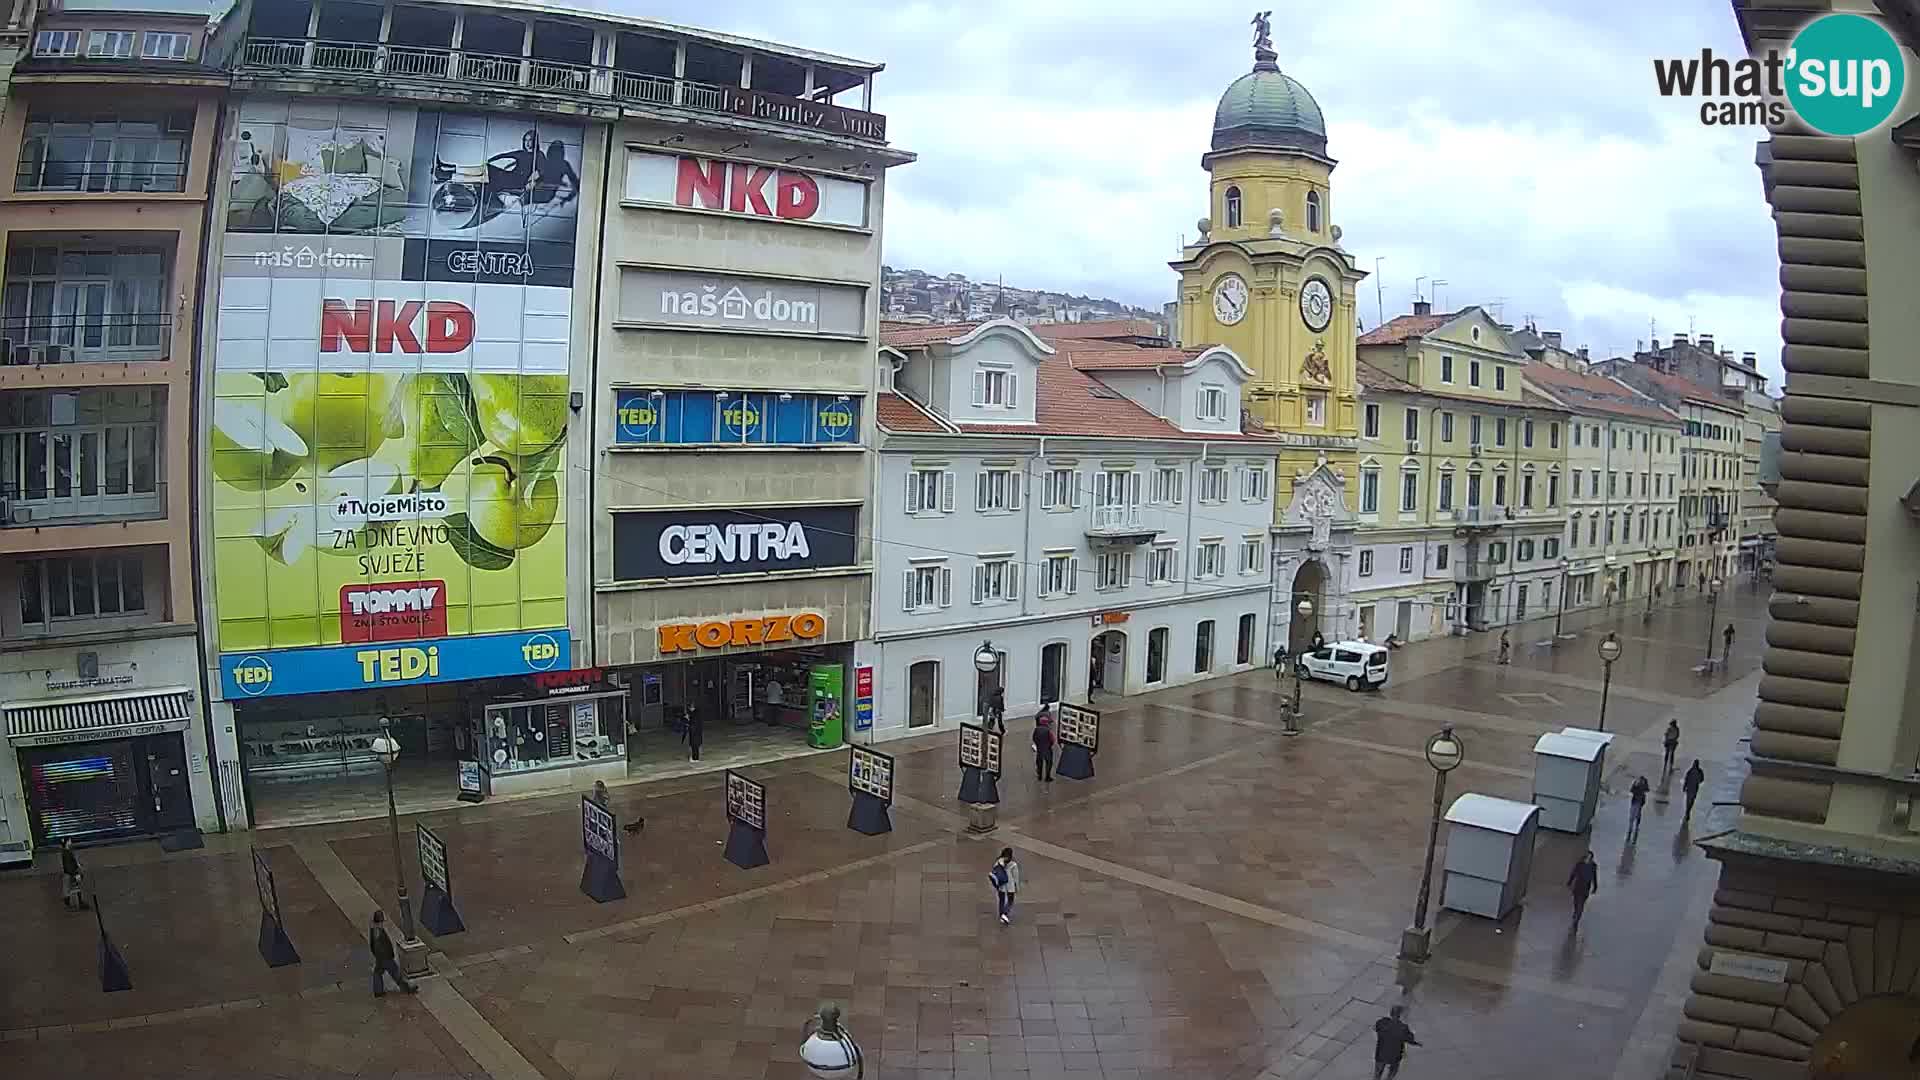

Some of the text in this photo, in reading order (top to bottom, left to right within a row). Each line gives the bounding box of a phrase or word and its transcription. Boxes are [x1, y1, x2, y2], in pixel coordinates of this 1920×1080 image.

[675, 158, 820, 220] NKD
[254, 246, 368, 269] naš dom
[447, 250, 534, 275] CENTRA
[661, 285, 818, 324] naš dom
[320, 298, 476, 354] NKD
[618, 407, 657, 426] TEDi
[723, 409, 760, 427] TEDi
[819, 411, 853, 427] TEDi
[337, 497, 446, 517] #TvojeMisto
[333, 524, 450, 550] ZA DNEVNO
[659, 521, 810, 565] CENTRA
[359, 547, 426, 576] SVJEŽE
[347, 586, 439, 615] TOMMY
[658, 613, 825, 654] KORZO
[357, 646, 439, 683] TEDi
[522, 642, 560, 661] TEDi
[232, 665, 273, 684] TEDi
